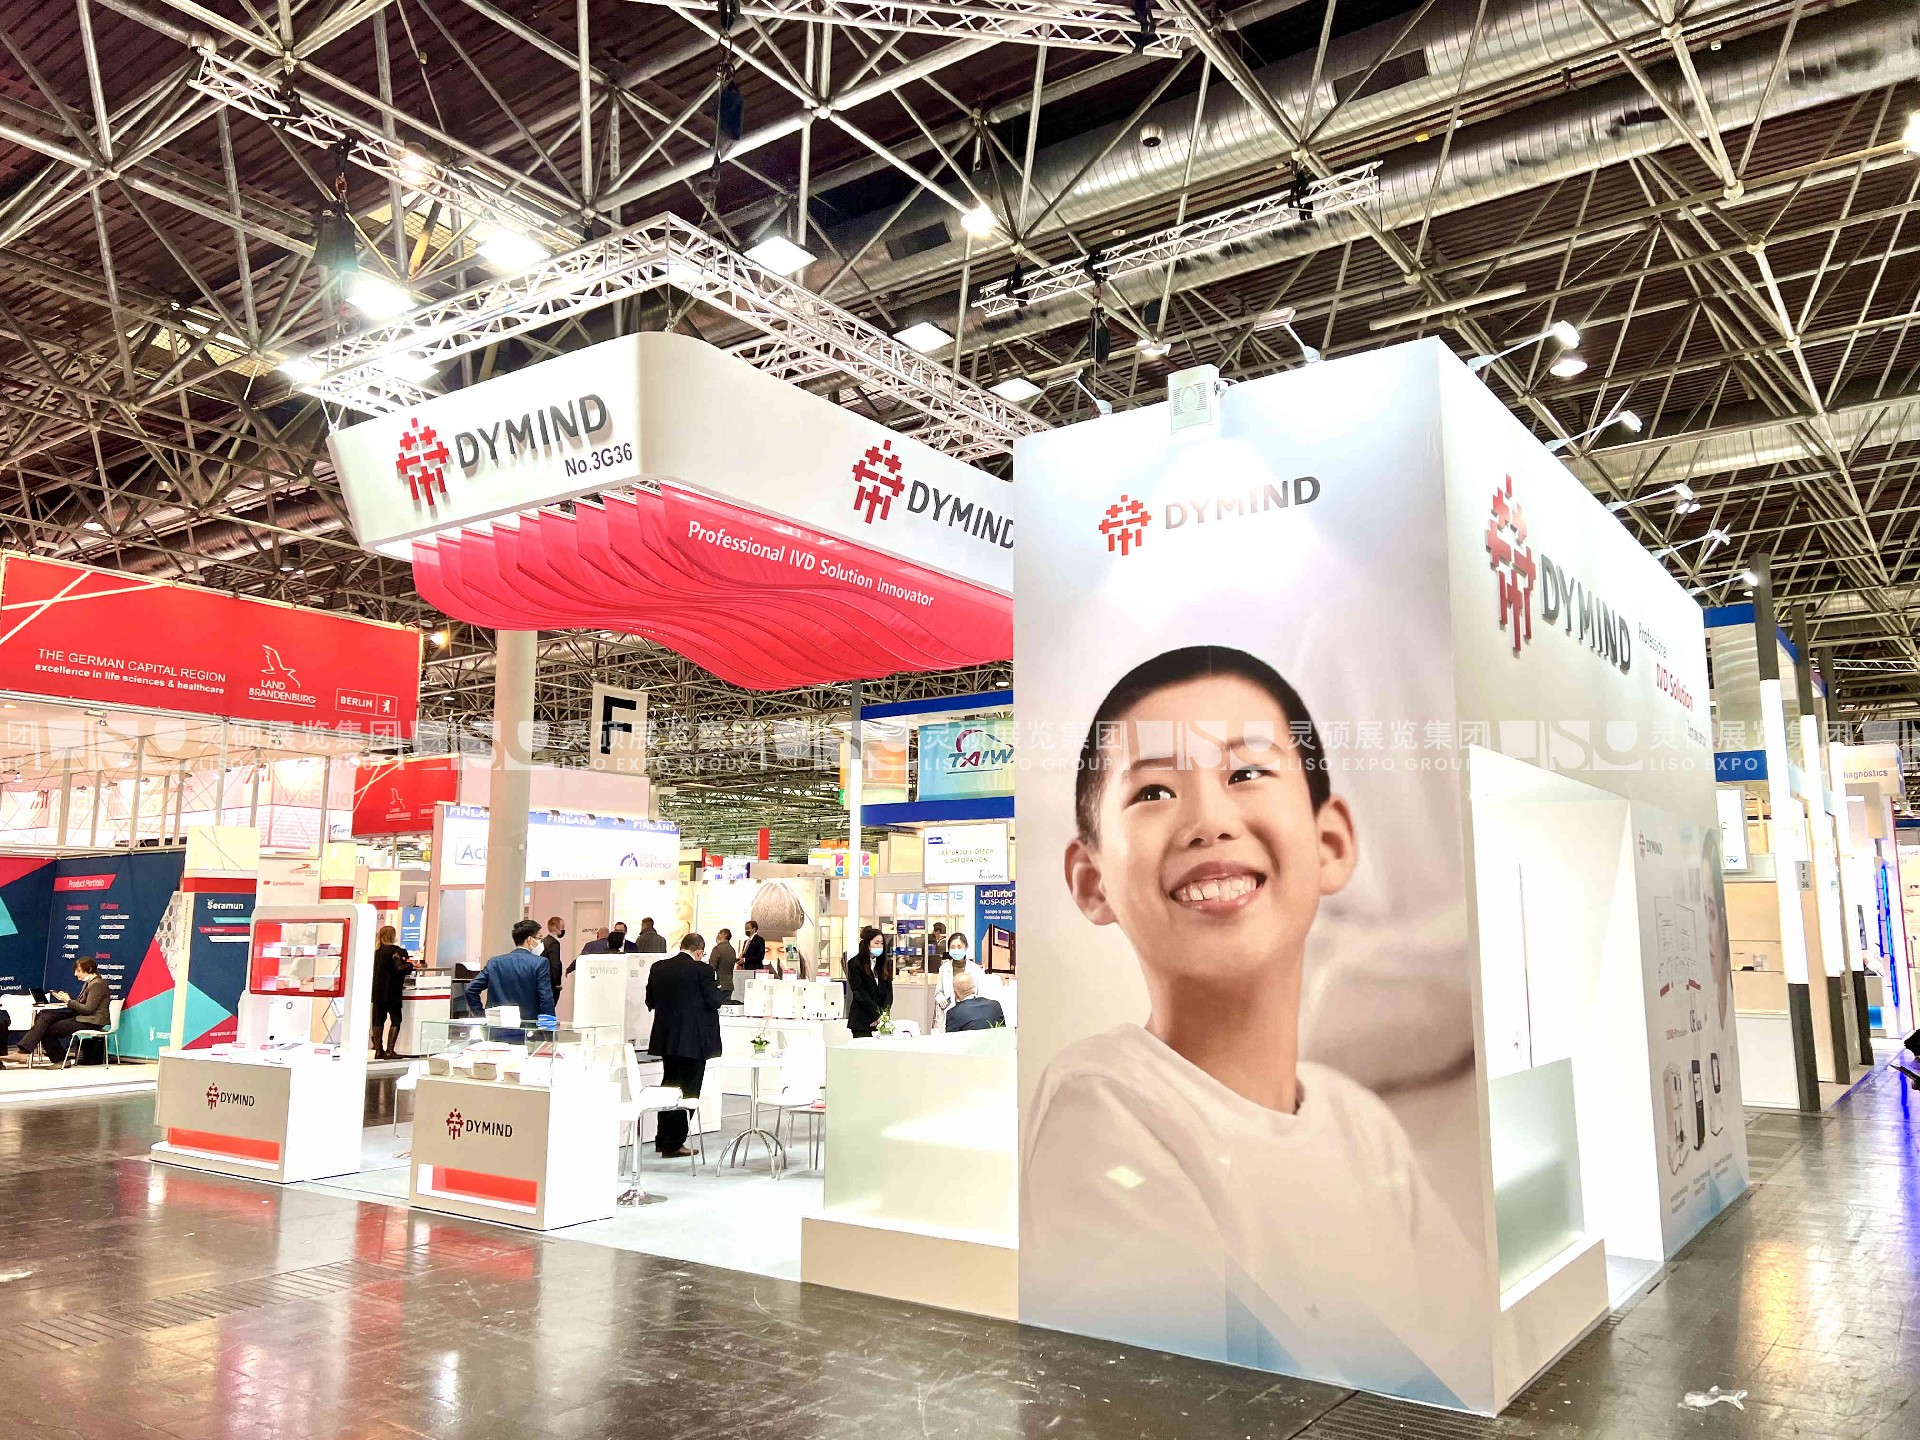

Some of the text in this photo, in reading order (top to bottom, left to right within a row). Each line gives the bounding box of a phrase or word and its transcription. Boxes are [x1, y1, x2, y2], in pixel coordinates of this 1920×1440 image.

[455, 394, 607, 468] DYMIND
[565, 443, 633, 477] No.3G36
[907, 480, 1014, 549] DYMIND
[1166, 476, 1321, 530] DYMIND
[688, 520, 934, 606] Professional IVD Solution Innovator
[1541, 553, 1631, 670] DYMIND
[1638, 621, 1668, 659] Professional
[35, 663, 225, 694] excellence in life sciences & healthcare
[38, 648, 226, 683] THE GERMAN CAPITAL REGION
[1656, 662, 1669, 692] IVD
[249, 687, 317, 704] BRANDENBURG
[261, 680, 286, 690] LAND
[1670, 673, 1693, 711] Solution
[340, 696, 373, 708] BERLIN
[601, 695, 637, 755] F
[948, 748, 1014, 768] TAIW
[1844, 769, 1888, 779] iagnostics
[547, 815, 596, 826] FINLAND
[633, 820, 677, 832] FINLAND
[68, 879, 105, 888] Product Portfolio
[207, 901, 244, 910] Seramun
[220, 1092, 255, 1107] DYMIND
[466, 1119, 513, 1138] DYMIND
